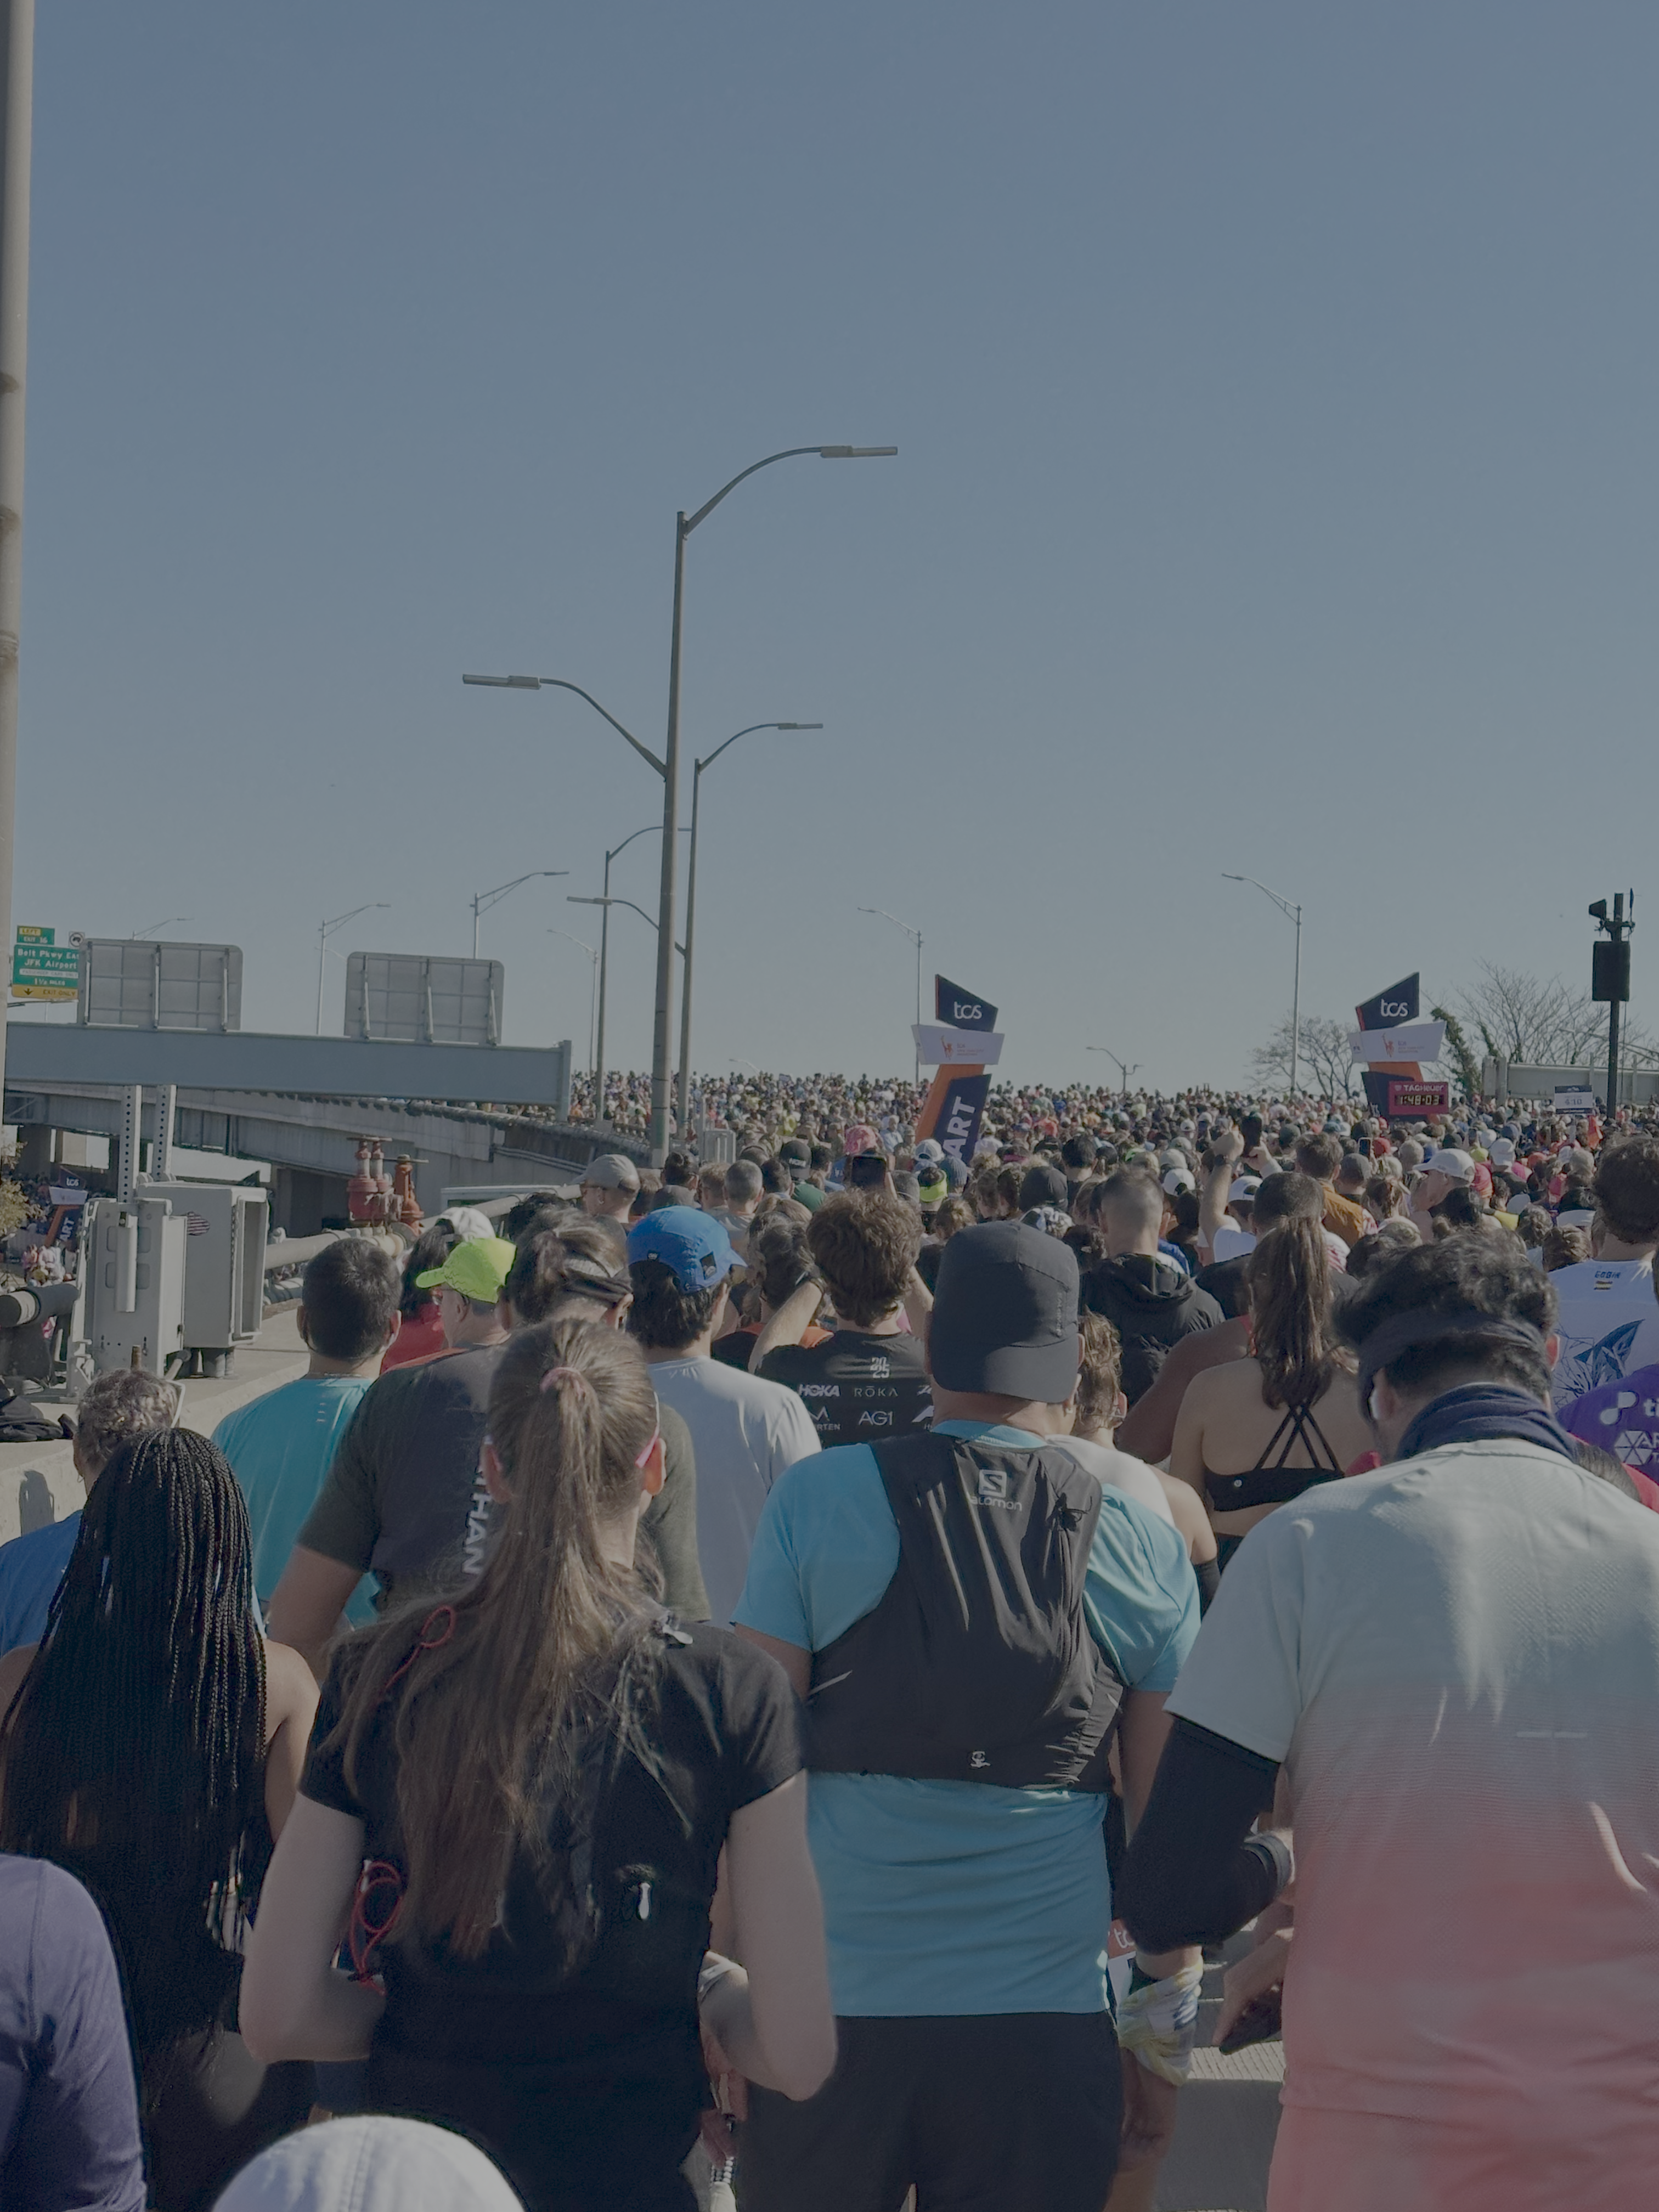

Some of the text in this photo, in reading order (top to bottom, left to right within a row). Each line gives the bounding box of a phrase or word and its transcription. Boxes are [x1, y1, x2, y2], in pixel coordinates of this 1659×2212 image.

[40, 950, 63, 960] Pkwy
[24, 958, 77, 969] JFK Airport
[954, 1001, 983, 1019] tcs
[1380, 998, 1409, 1017] tcs
[943, 1096, 975, 1161] ART
[66, 1176, 80, 1187] tcs
[59, 1217, 75, 1242] ART
[799, 1384, 840, 1397] HOKA
[859, 1410, 894, 1426] AG1
[969, 1496, 1023, 1512] alomon
